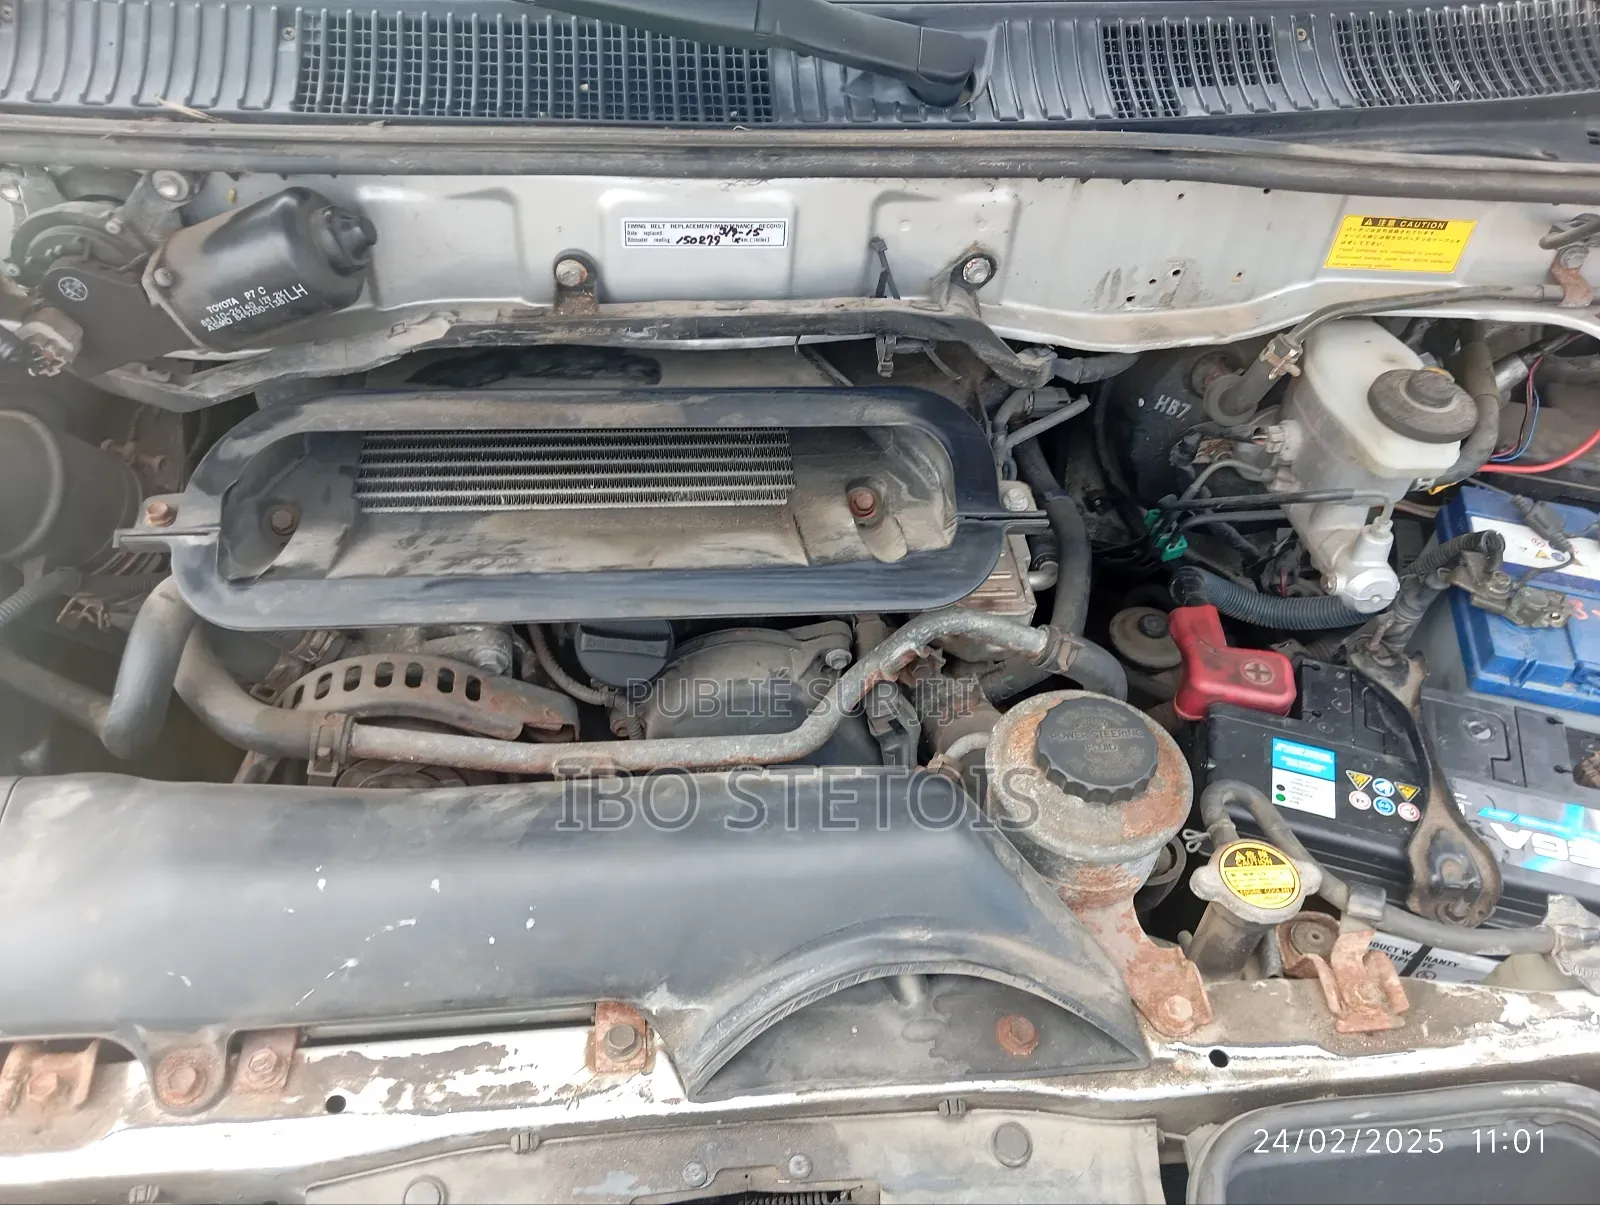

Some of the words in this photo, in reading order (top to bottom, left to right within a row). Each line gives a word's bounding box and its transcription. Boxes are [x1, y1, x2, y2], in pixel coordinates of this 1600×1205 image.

[1400, 220, 1446, 230] CAUTION
[283, 283, 309, 301] LH
[206, 297, 240, 314] TOYOTA
[244, 290, 256, 301] P7
[257, 286, 266, 295] C
[207, 317, 233, 332] ASMO
[1153, 394, 1192, 419] HB7
[1049, 730, 1089, 742] POWER
[1090, 727, 1146, 739] STEERING
[1084, 743, 1119, 753] FLUID
